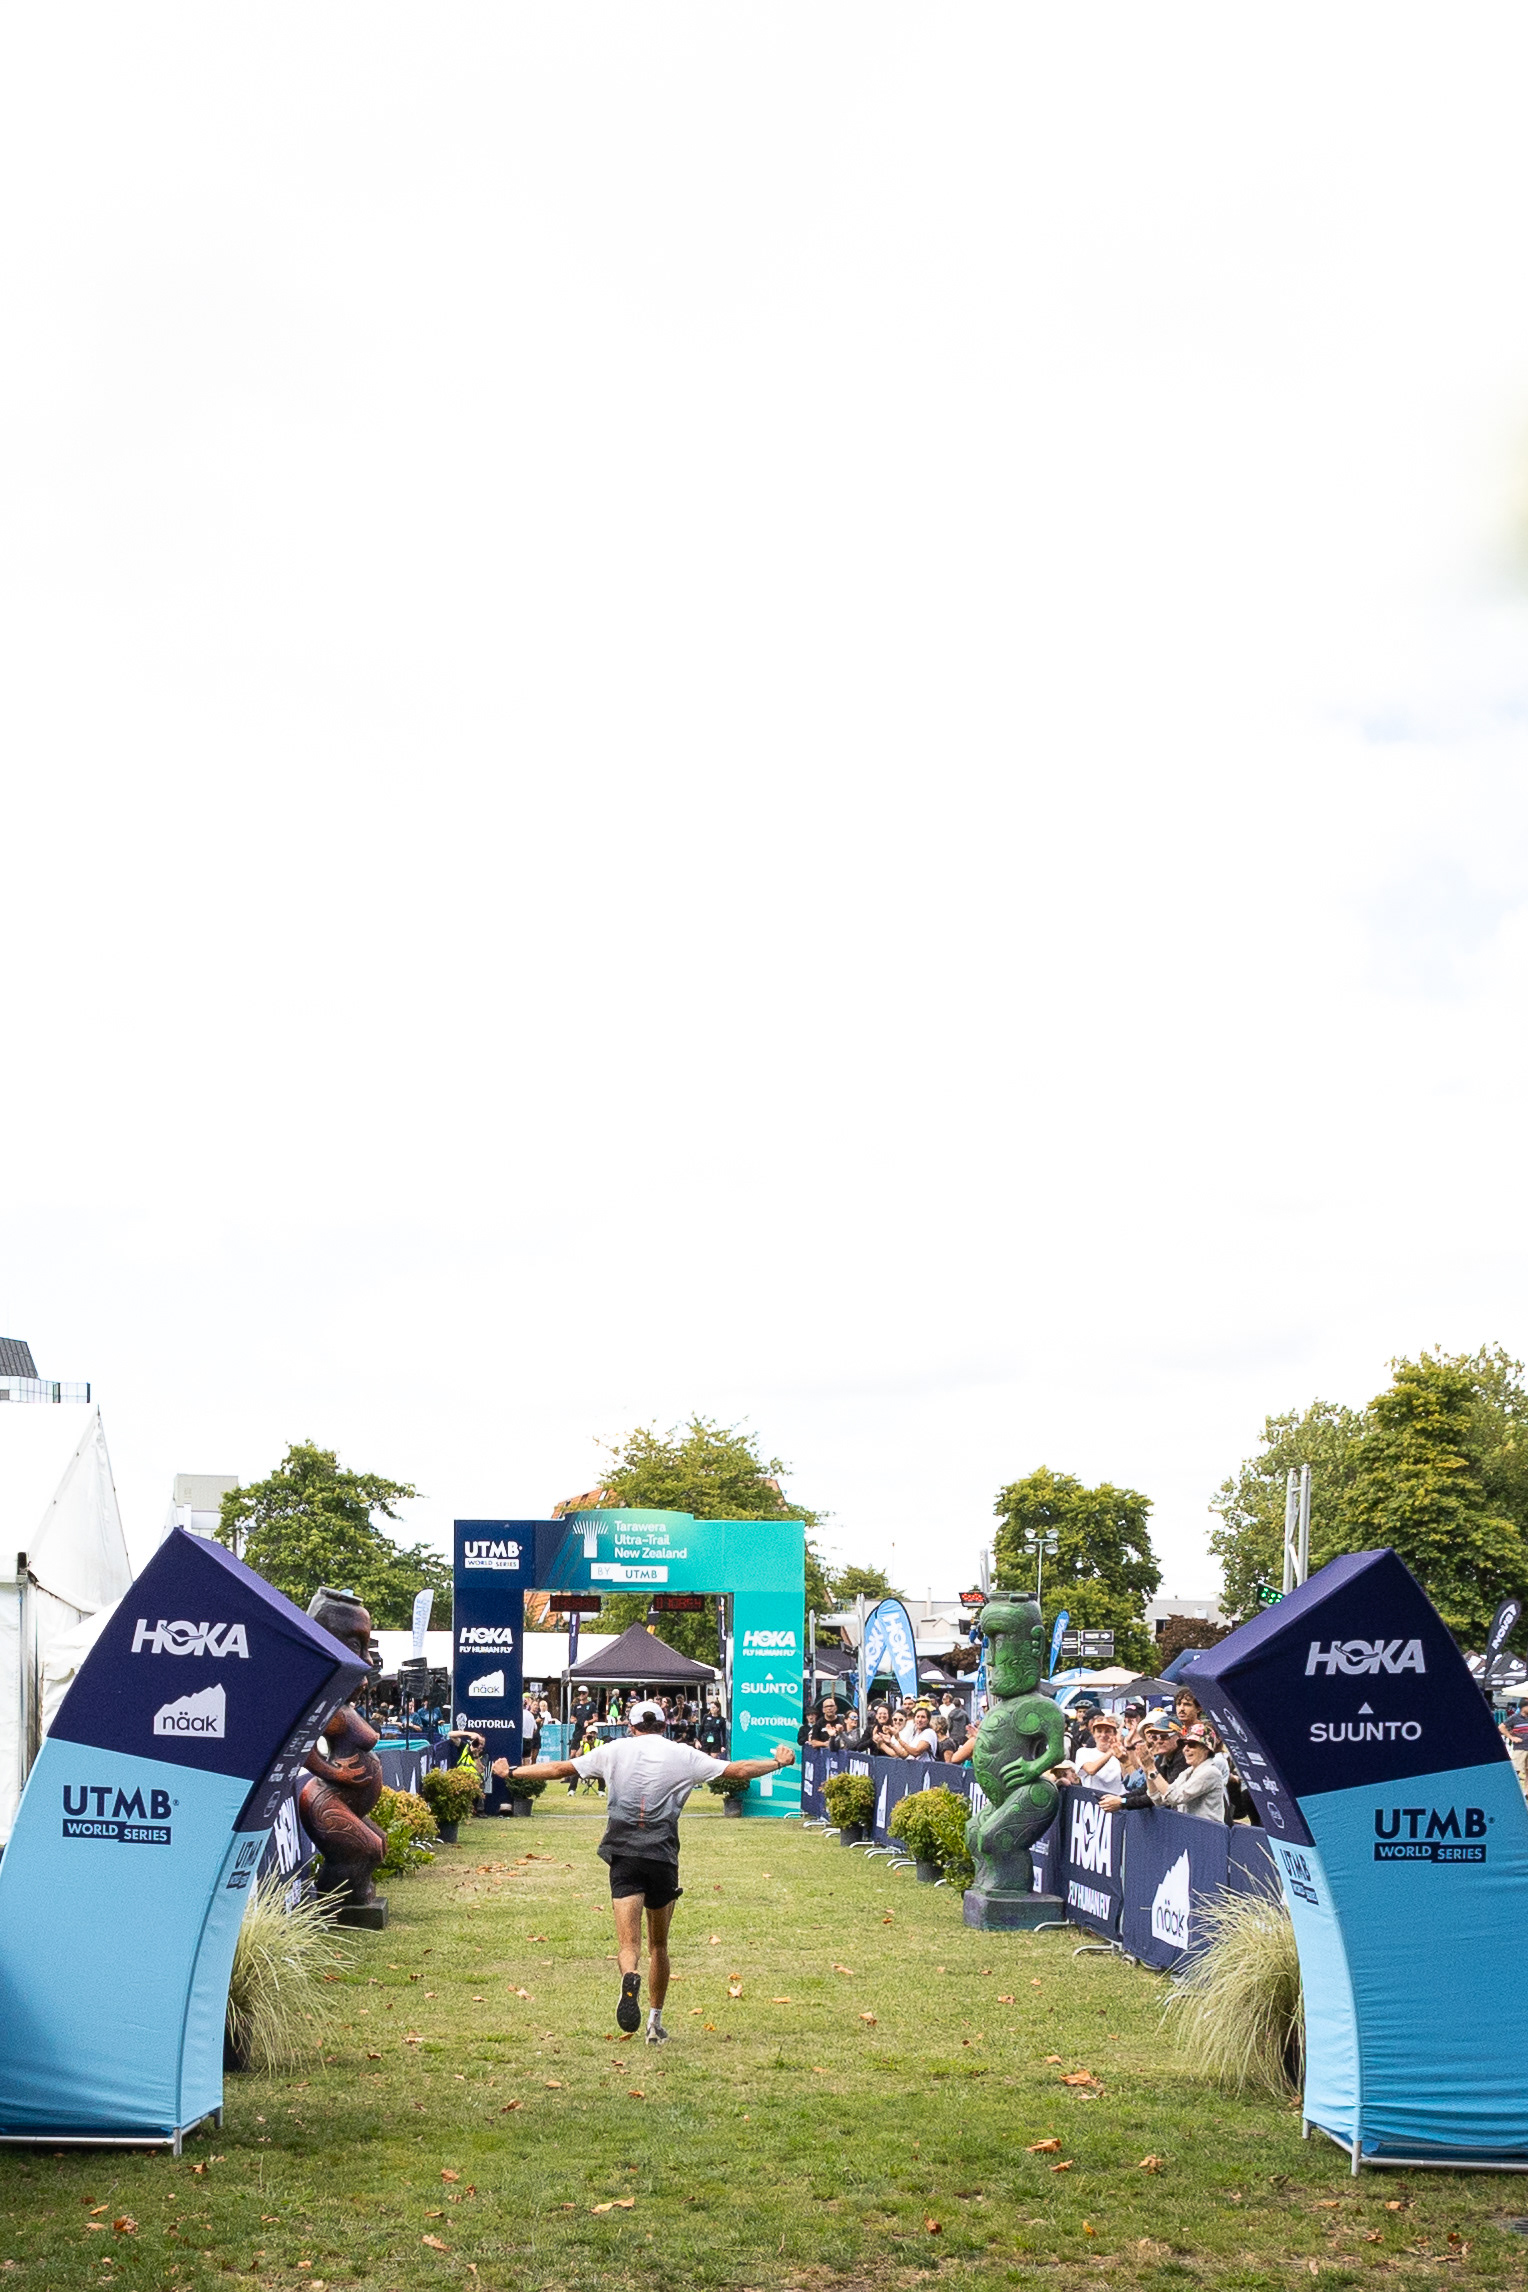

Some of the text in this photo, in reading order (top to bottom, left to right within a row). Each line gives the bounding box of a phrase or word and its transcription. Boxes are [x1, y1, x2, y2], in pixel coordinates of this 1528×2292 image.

[614, 1521, 666, 1532] Tarawera
[614, 1534, 670, 1545] Ultra-Trail
[614, 1547, 687, 1559] New Zealand
[597, 1567, 658, 1579] BY UTMB
[131, 1618, 251, 1659] HOKA
[459, 1628, 513, 1644] HOKA
[743, 1630, 796, 1647] HOKA
[473, 1646, 499, 1654] HUMAN
[500, 1646, 513, 1654] FLY
[882, 1612, 915, 1676] HOKA
[755, 1649, 783, 1657] HUMAN
[1304, 1639, 1426, 1676] HOKA
[473, 1684, 500, 1694] näak
[740, 1682, 798, 1694] SUUNTO
[162, 1711, 217, 1732] näak
[467, 1720, 515, 1729] ROTORUA
[750, 1717, 798, 1726] ROTORUA
[1309, 1721, 1422, 1742] SUUNTO
[67, 1822, 168, 1842] WORLD SERIES
[1069, 1799, 1112, 1878] HOKA
[1379, 1846, 1482, 1860] WORLD SERIES
[1156, 1899, 1186, 1938] näak
